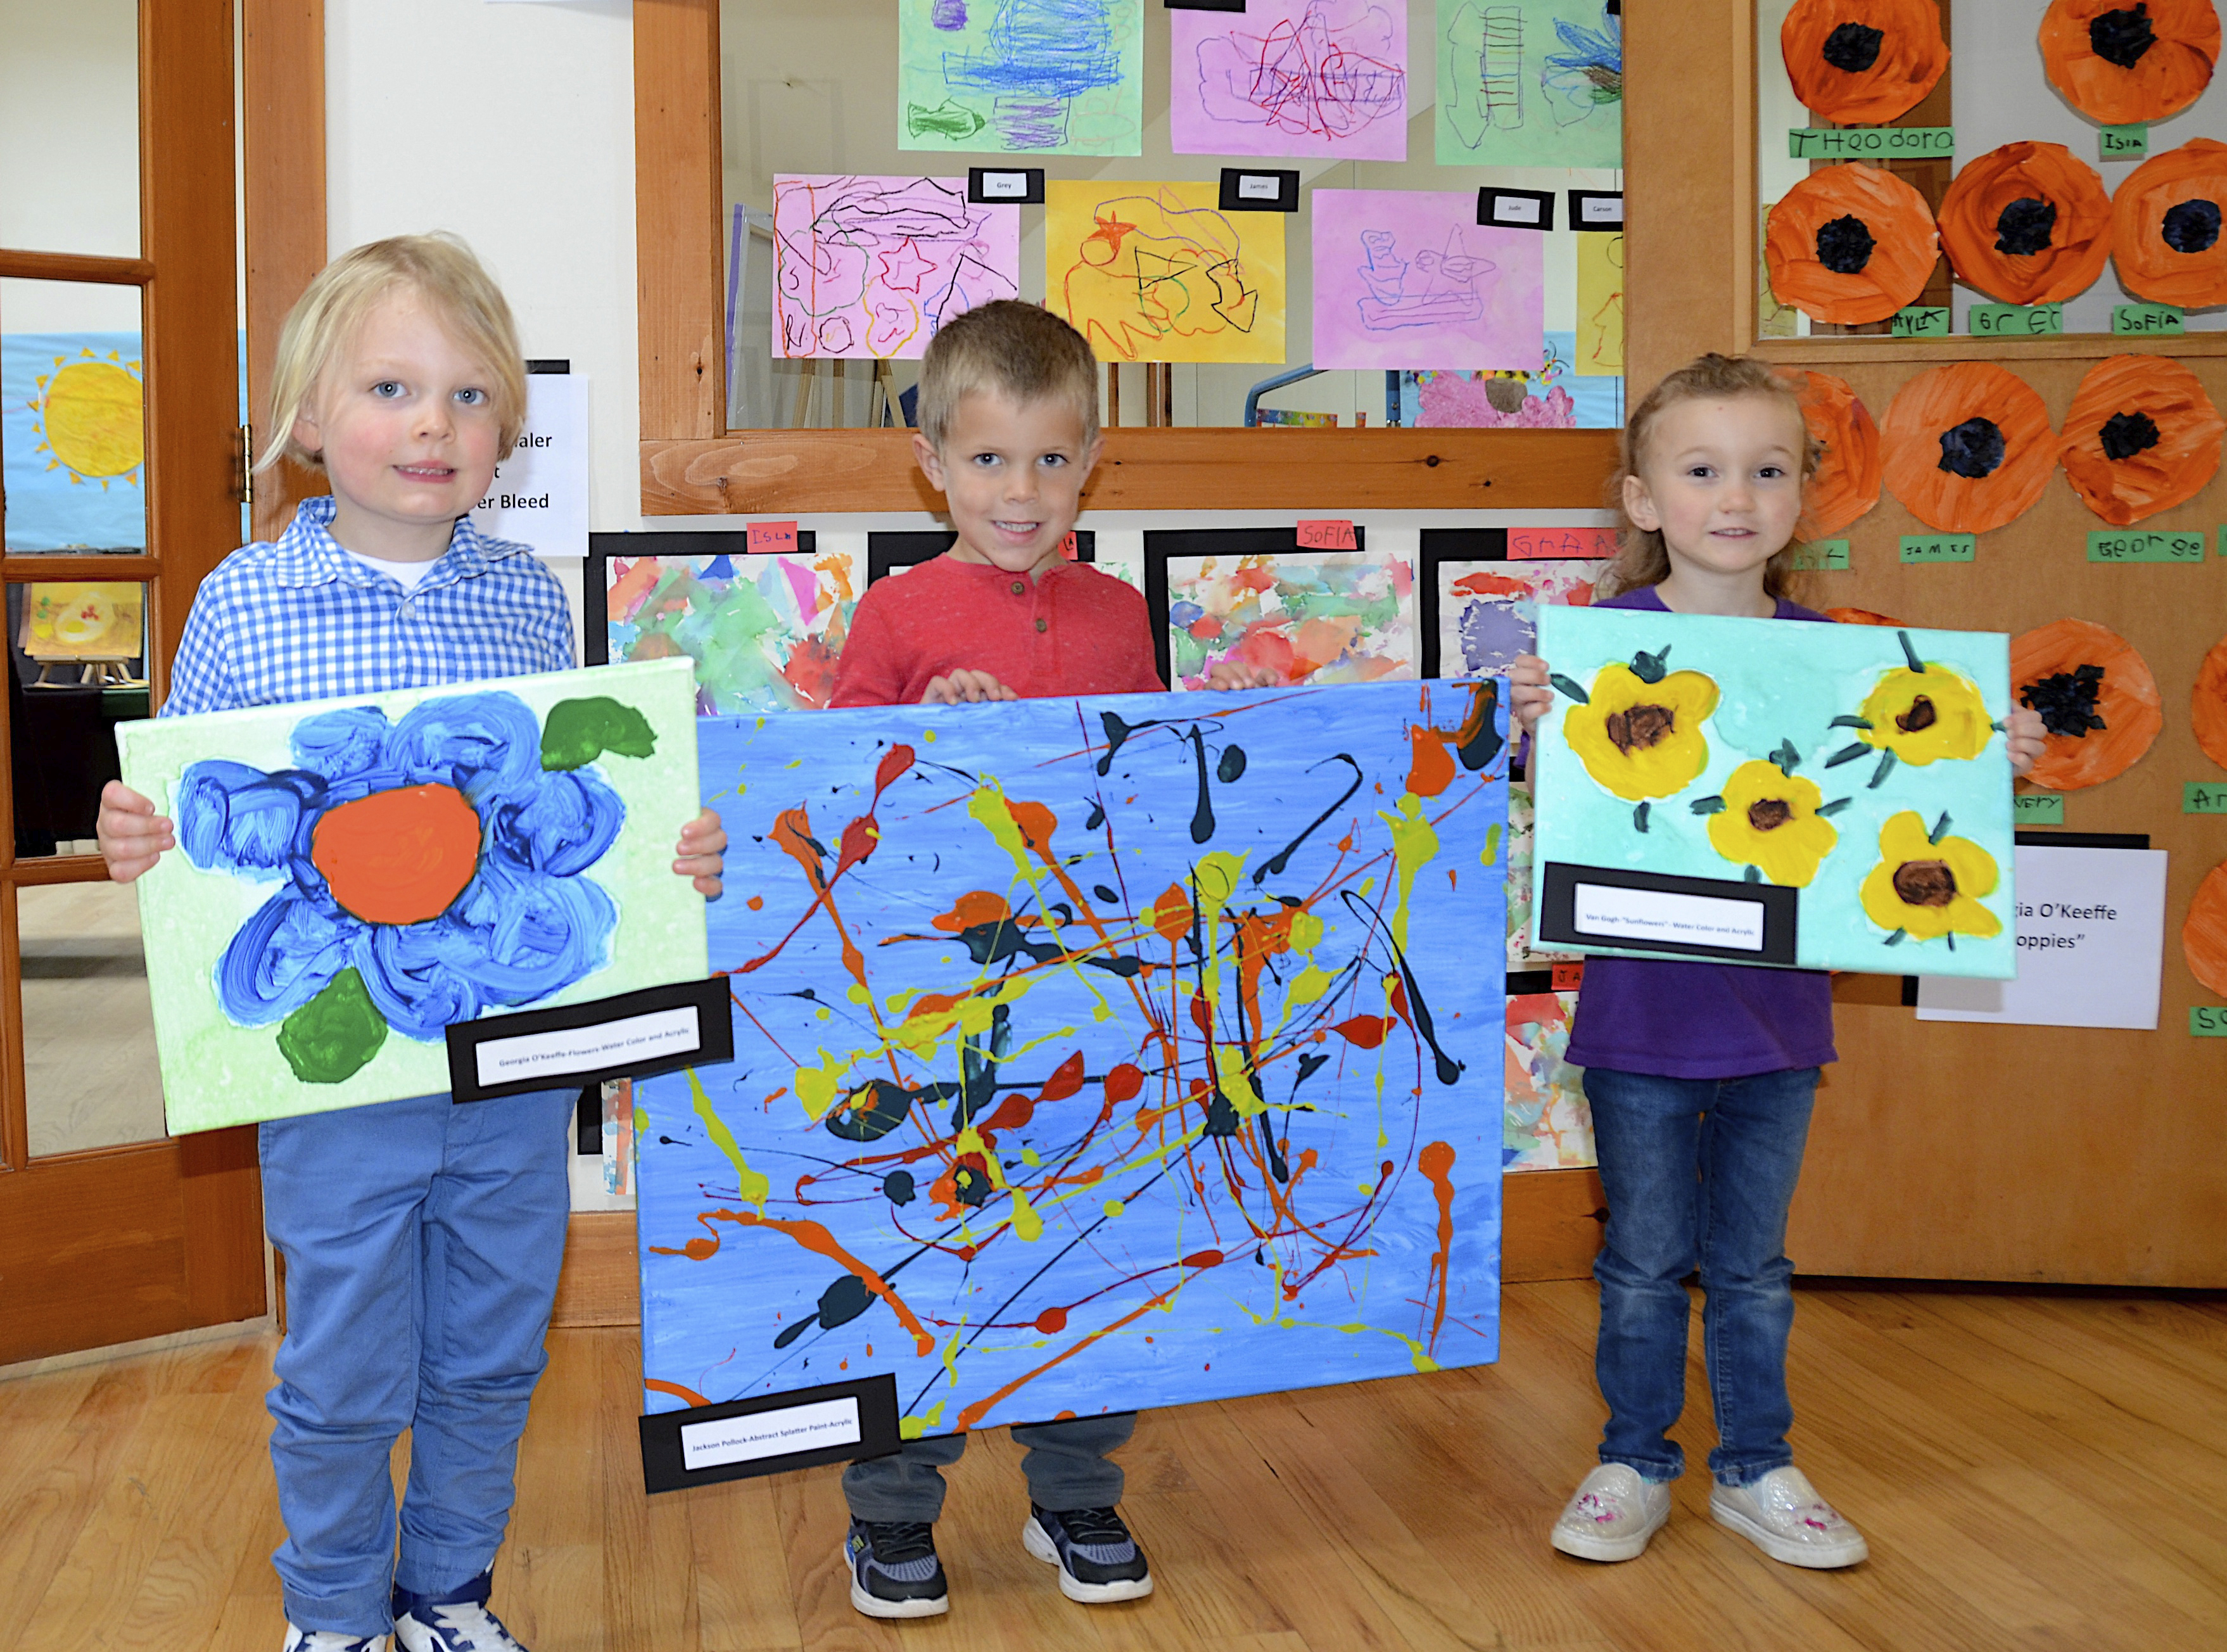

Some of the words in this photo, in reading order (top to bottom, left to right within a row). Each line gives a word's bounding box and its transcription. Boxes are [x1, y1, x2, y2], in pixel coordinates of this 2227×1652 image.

[515, 433, 552, 447] aler
[500, 493, 549, 509] Bleed
[1732, 928, 1754, 936] Acrylic
[2017, 933, 2085, 950] oppies”
[499, 1057, 530, 1067] Georgia
[649, 1032, 662, 1041] and
[693, 1443, 720, 1451] Jackson
[780, 1427, 807, 1438] Splatter
